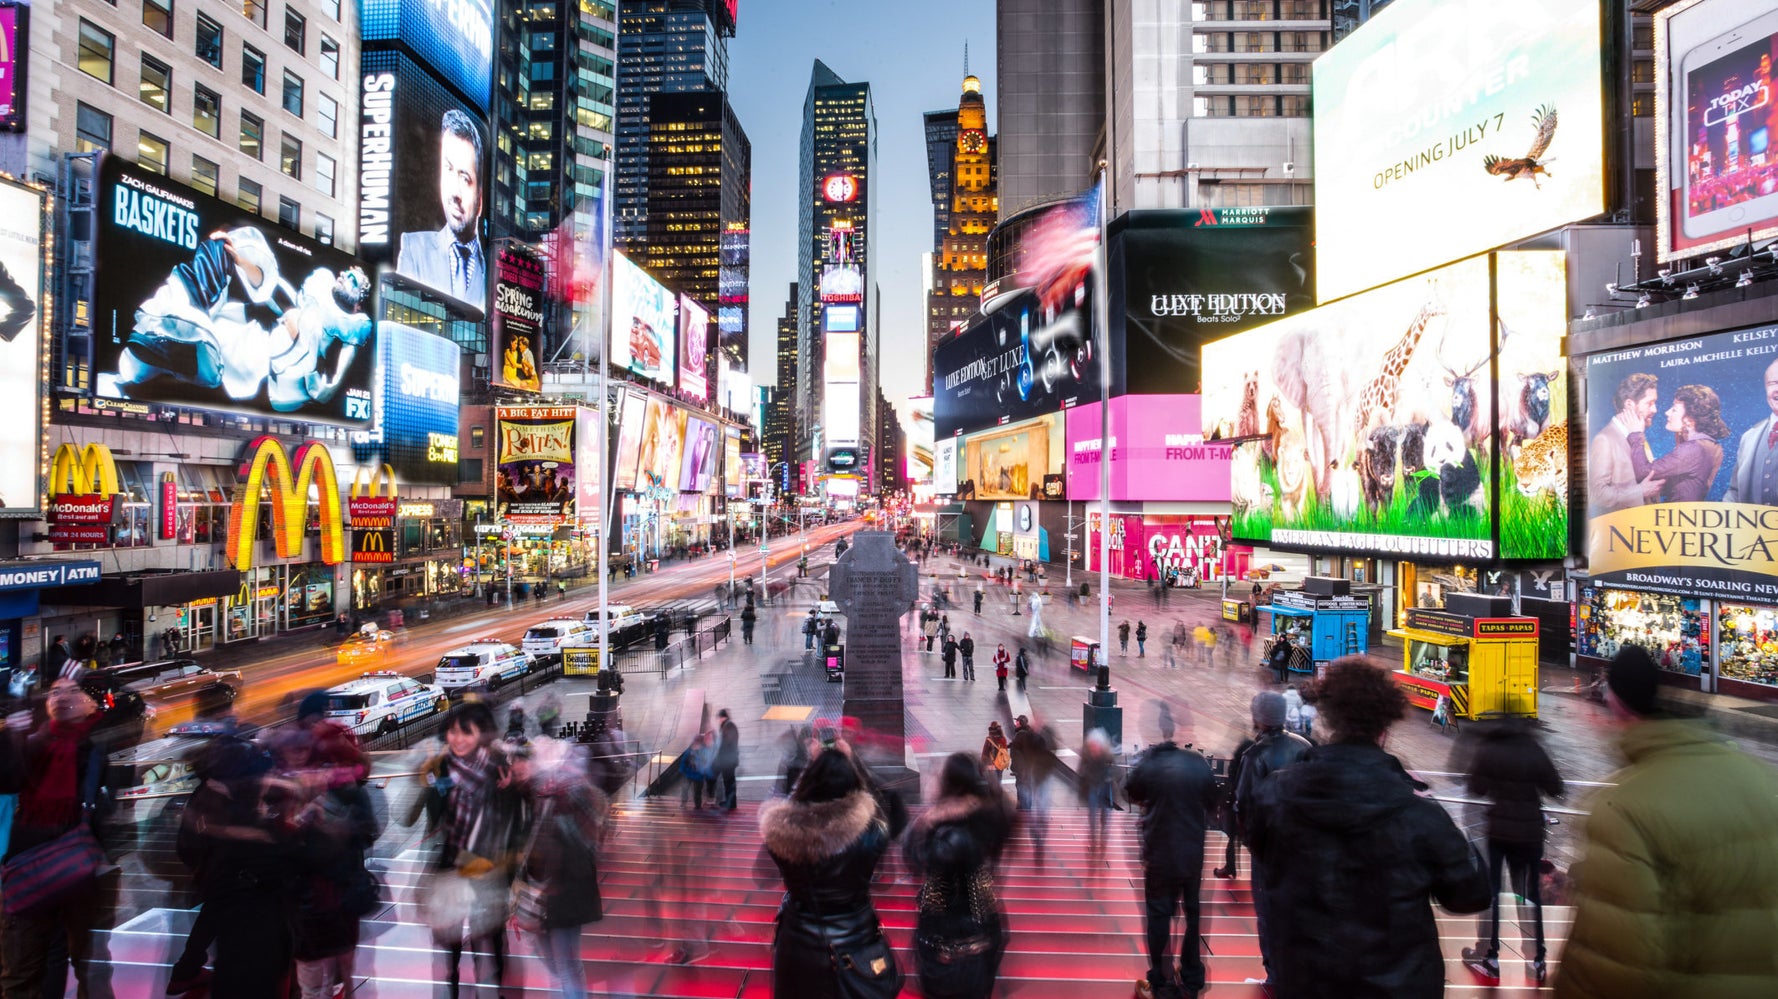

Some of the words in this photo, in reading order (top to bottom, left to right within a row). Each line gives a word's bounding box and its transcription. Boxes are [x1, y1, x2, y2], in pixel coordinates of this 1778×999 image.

[1710, 79, 1763, 106] TODAY
[1722, 96, 1751, 117] TIX
[360, 72, 395, 243] SUPERHUMAN
[1373, 143, 1444, 190] OPENING
[1447, 120, 1488, 157] JULY
[1494, 112, 1505, 131] 7
[121, 173, 144, 191] ZACH
[145, 183, 195, 210] GALIFIANAKIS
[114, 183, 199, 251] BASKETS
[1221, 216, 1265, 224] MARQUIS
[1222, 207, 1270, 216] MARRIOTT
[496, 283, 533, 309] SPRING
[1208, 293, 1287, 311] EDITION
[495, 300, 544, 328] awakening
[1197, 315, 1219, 323] Beats
[1733, 329, 1777, 344] KELSEY
[1000, 344, 1026, 373] LUXE
[1592, 350, 1641, 366] MATTHEW
[1644, 340, 1703, 357] MORRISON
[1660, 357, 1691, 368] LAURA
[1692, 349, 1743, 364] MICHELLE
[1746, 344, 1778, 356] KELLY
[945, 372, 960, 391] LUXE
[960, 357, 987, 385] EDITION
[346, 389, 361, 397] JAN
[346, 397, 368, 419] FX
[532, 408, 550, 417] FAT
[511, 425, 563, 433] SOMETHING
[504, 426, 570, 458] ROTTEN!
[1075, 452, 1089, 464] FROM
[1166, 447, 1205, 460] FROM
[49, 503, 109, 513] McDonald's
[350, 502, 395, 510] McDonald's
[398, 504, 433, 516] EXPRESS
[1654, 509, 1778, 530] FINDING
[1274, 530, 1334, 548] AMERICAN
[1339, 533, 1382, 550] EAGLE
[1385, 535, 1490, 558] OUTFITTERS
[0, 570, 59, 586] MONEY
[68, 567, 99, 580] ATM
[1626, 572, 1693, 587] BROADWAY'S
[1695, 578, 1751, 592] SOARING
[566, 653, 598, 663] Beautiful
